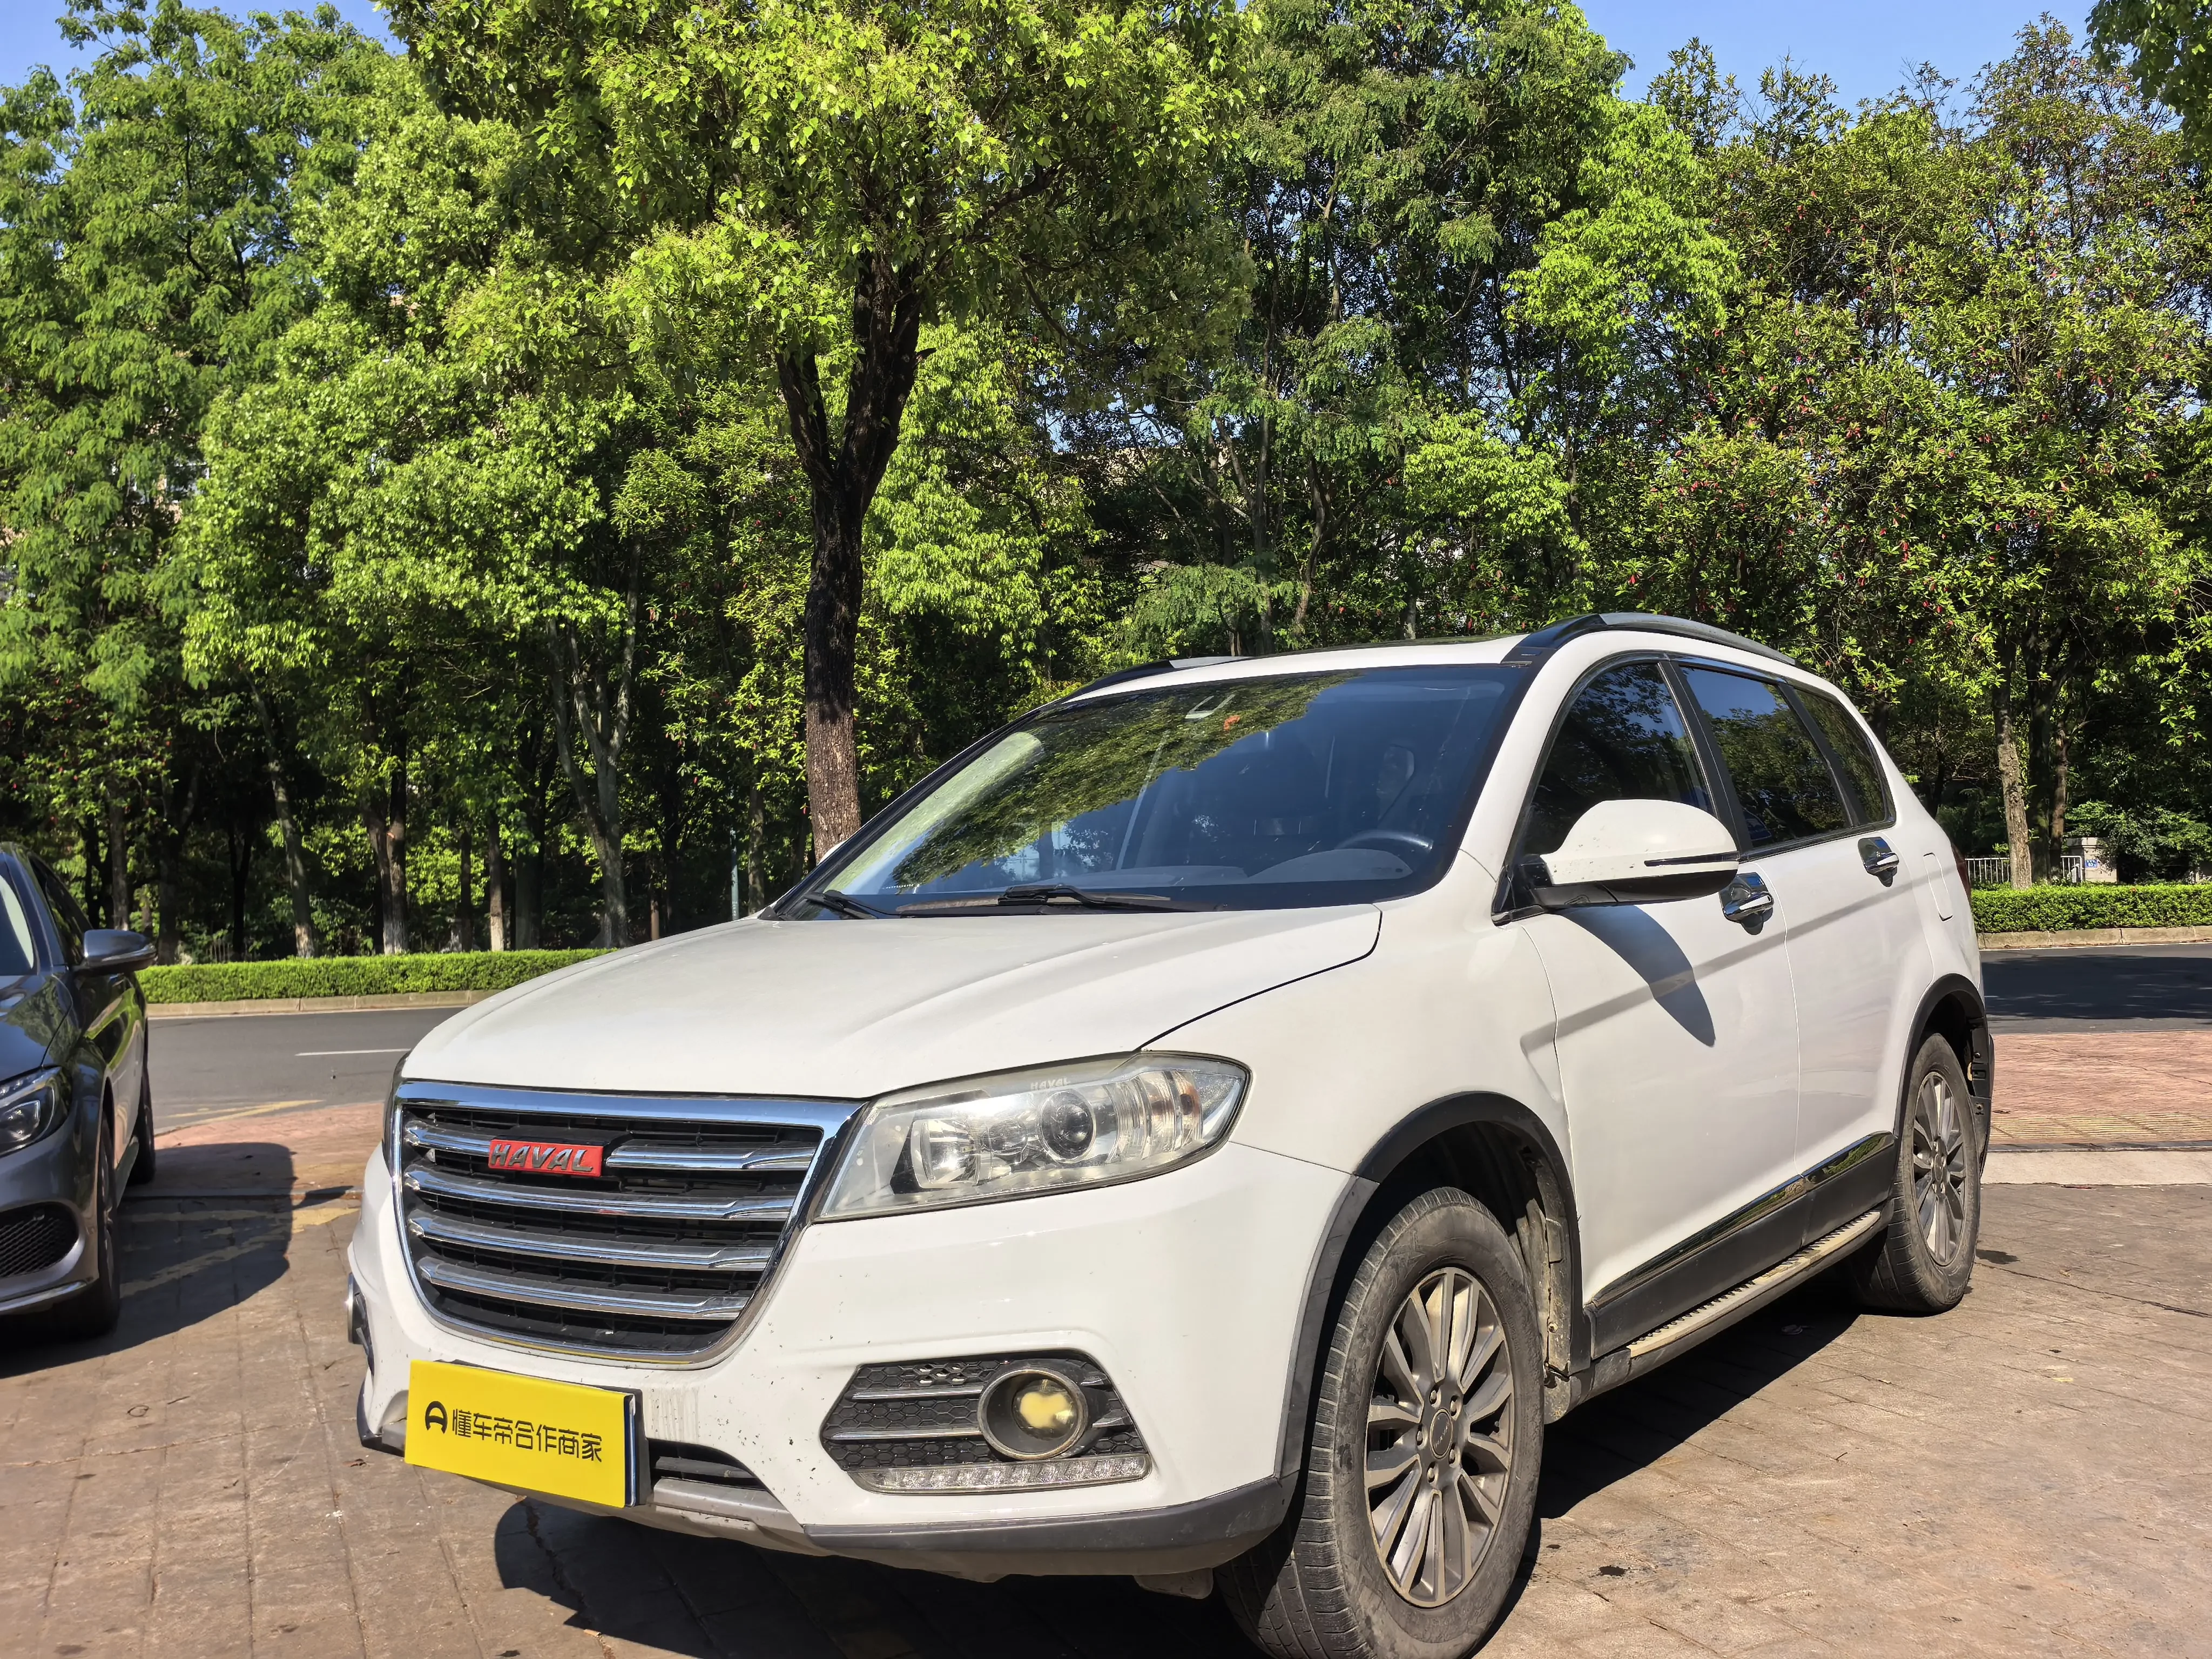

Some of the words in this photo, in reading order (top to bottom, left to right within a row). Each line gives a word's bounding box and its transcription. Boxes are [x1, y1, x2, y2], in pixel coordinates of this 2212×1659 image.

[1031, 1077, 1070, 1090] HAVAL
[490, 1143, 594, 1172] HAVAL
[452, 1408, 602, 1462] 懂车帝合作商家
